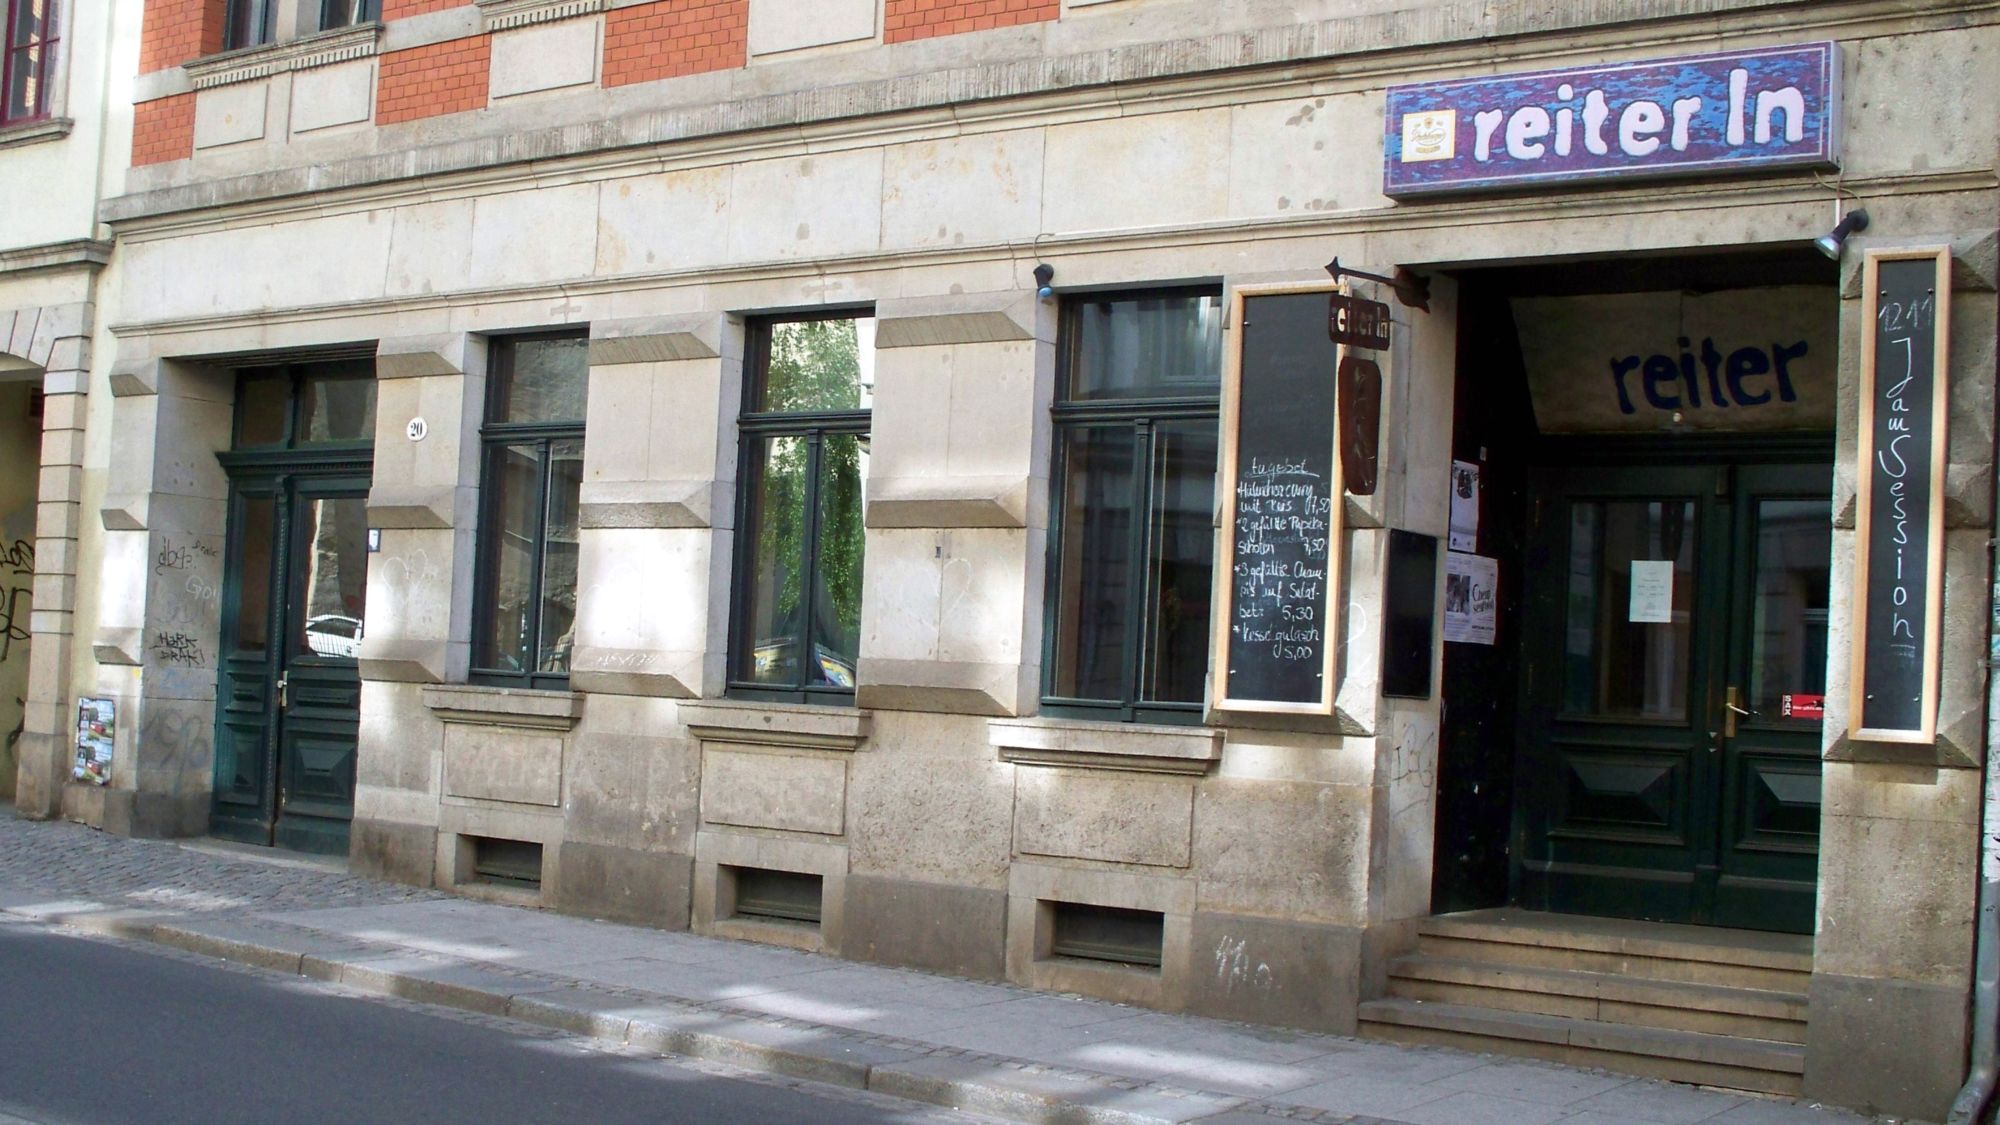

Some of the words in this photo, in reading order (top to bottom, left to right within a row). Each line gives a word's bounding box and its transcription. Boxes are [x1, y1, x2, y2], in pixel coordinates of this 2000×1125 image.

[1474, 83, 1702, 162] reiter
[1726, 68, 1805, 147] In
[1609, 335, 1809, 415] reiter
[410, 421, 423, 437] 20
[1241, 517, 1249, 533] 2
[1239, 561, 1249, 577] 3
[1281, 604, 1314, 622] 5,30
[1284, 645, 1313, 661] 5,00
[1783, 694, 1792, 716] SAX
